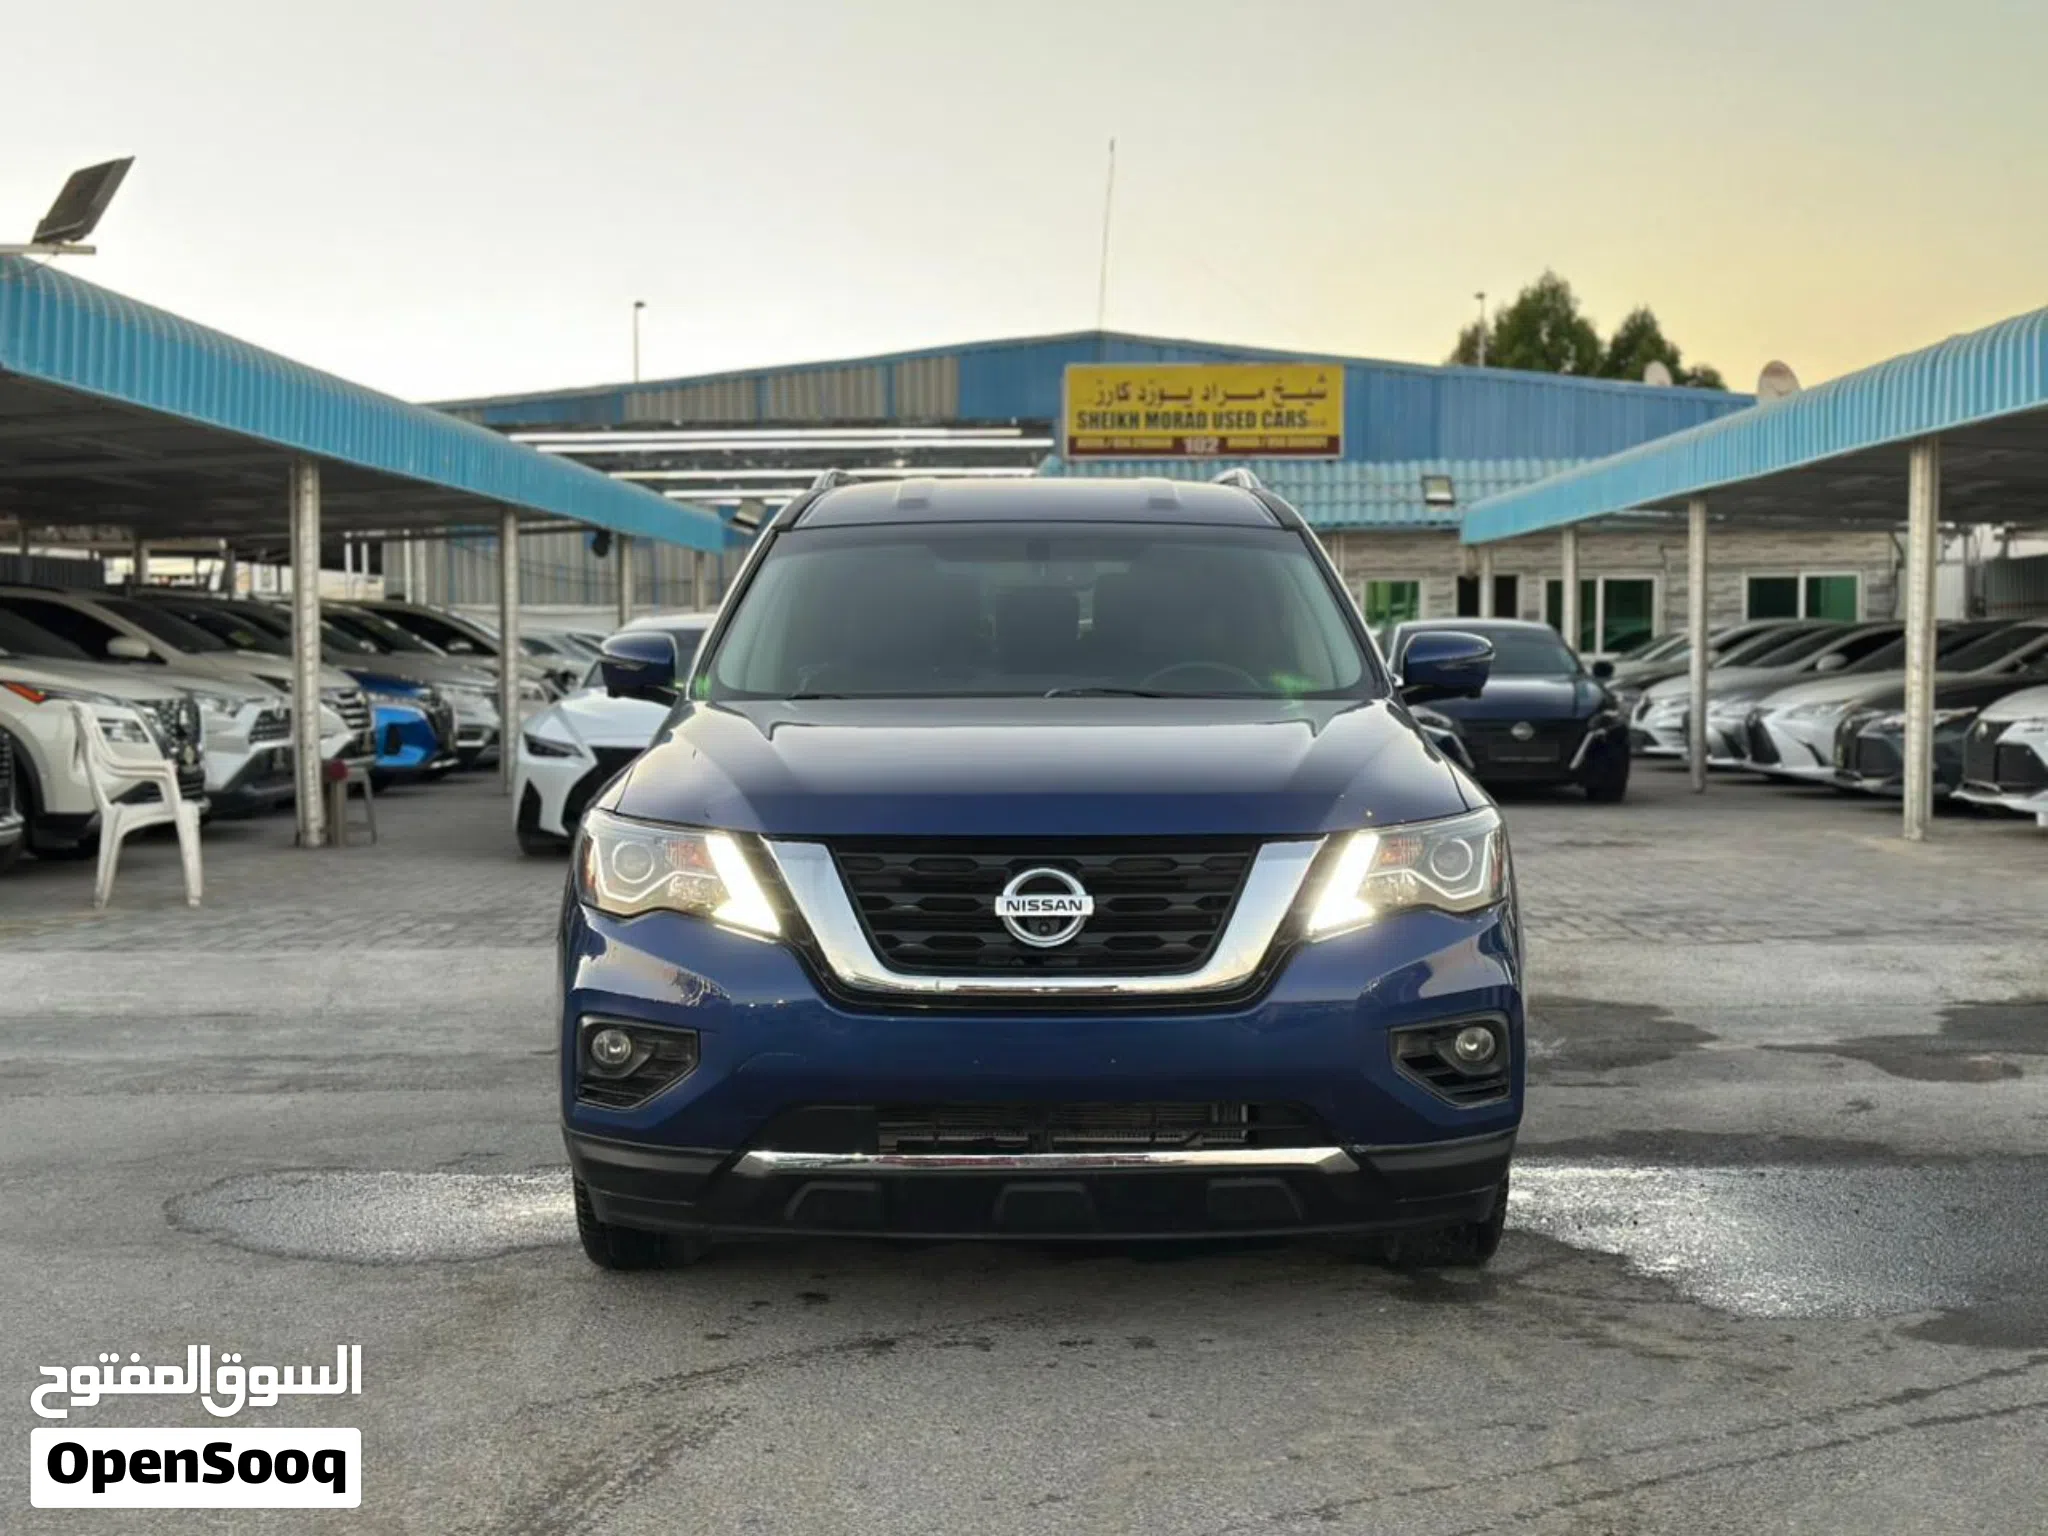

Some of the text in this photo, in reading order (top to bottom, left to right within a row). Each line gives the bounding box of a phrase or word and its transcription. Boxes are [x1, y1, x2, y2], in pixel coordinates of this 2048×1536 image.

[1076, 410, 1140, 430] SHEIKH
[1145, 410, 1207, 429] MORAD
[1212, 410, 1257, 428] USED
[1261, 409, 1308, 427] CARS
[1006, 899, 1083, 911] NISSAN
